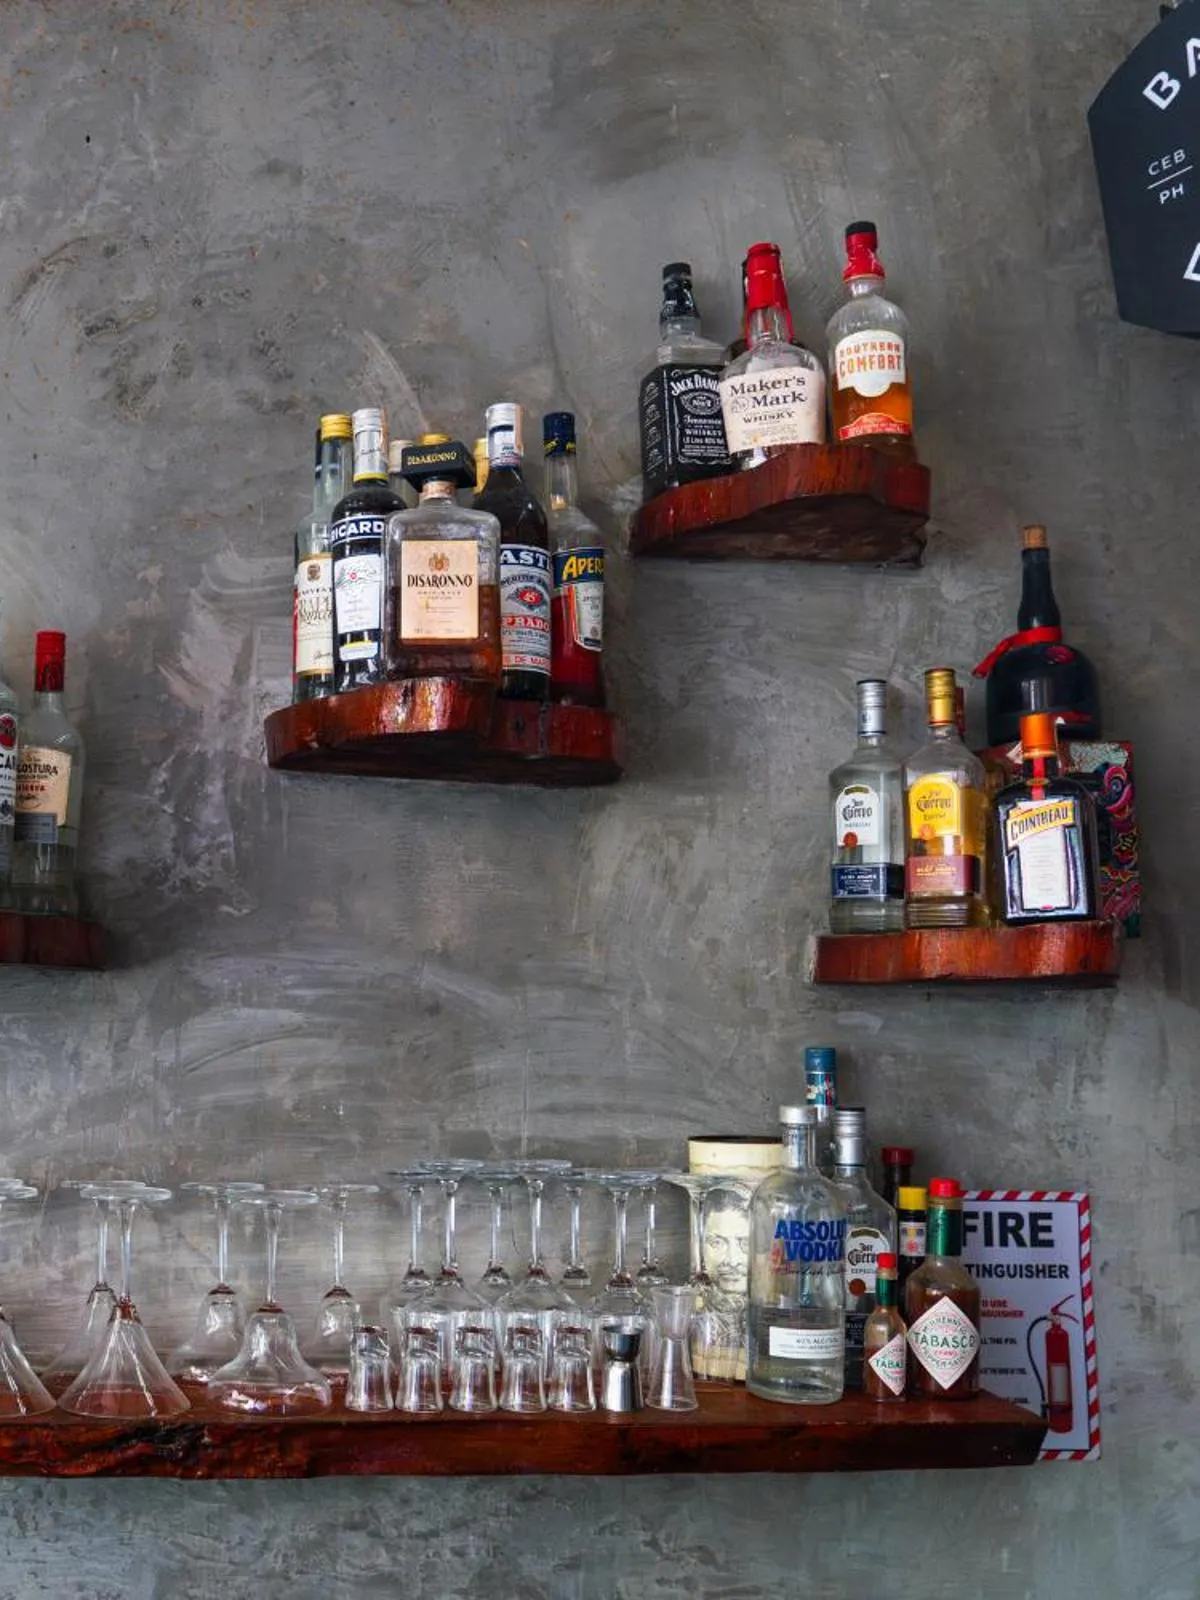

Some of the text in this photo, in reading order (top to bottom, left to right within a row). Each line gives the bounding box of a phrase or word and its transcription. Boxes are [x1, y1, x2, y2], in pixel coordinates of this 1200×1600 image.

[1147, 149, 1187, 176] CEB
[1159, 183, 1185, 205] PH
[839, 342, 901, 357] SOUTHERN
[839, 354, 902, 379] COMFORT
[670, 377, 694, 397] JACK
[730, 375, 806, 397] Maker's
[743, 410, 796, 424] WHISKY
[407, 451, 457, 466] DISARONNO
[406, 573, 473, 590] DISARONNO
[1010, 805, 1069, 842] COINTREAU
[961, 1210, 1055, 1248] FIRE
[911, 1332, 976, 1348] TABASCO
